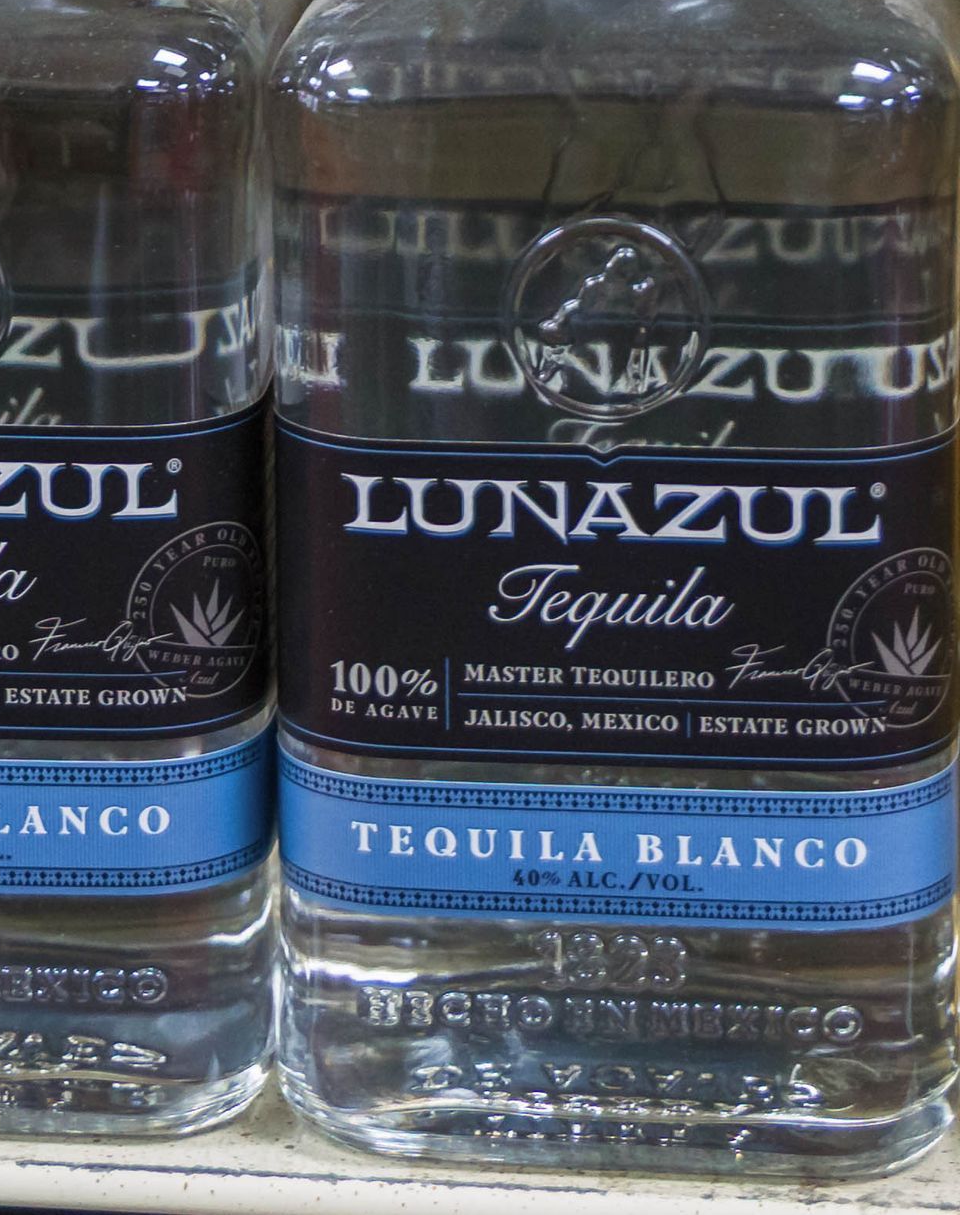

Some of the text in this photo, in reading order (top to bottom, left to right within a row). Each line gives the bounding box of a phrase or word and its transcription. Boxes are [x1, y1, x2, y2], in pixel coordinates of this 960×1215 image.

[152, 531, 208, 572] YEAR
[854, 559, 908, 598] YEAR
[488, 564, 734, 651] Tequila
[148, 648, 202, 666] WEBER
[330, 659, 438, 697] 100%
[464, 663, 715, 689] MASTER TEQUILERO
[4, 686, 188, 706] ESTATE GROWN
[331, 698, 439, 721] DE AGAVE
[464, 707, 679, 732] JALISCO, MEXICO
[699, 715, 887, 736] ESTATE GROWN
[350, 820, 869, 869] TEQUILA BLANCO
[512, 868, 704, 893] 40% ALC./VOL.
